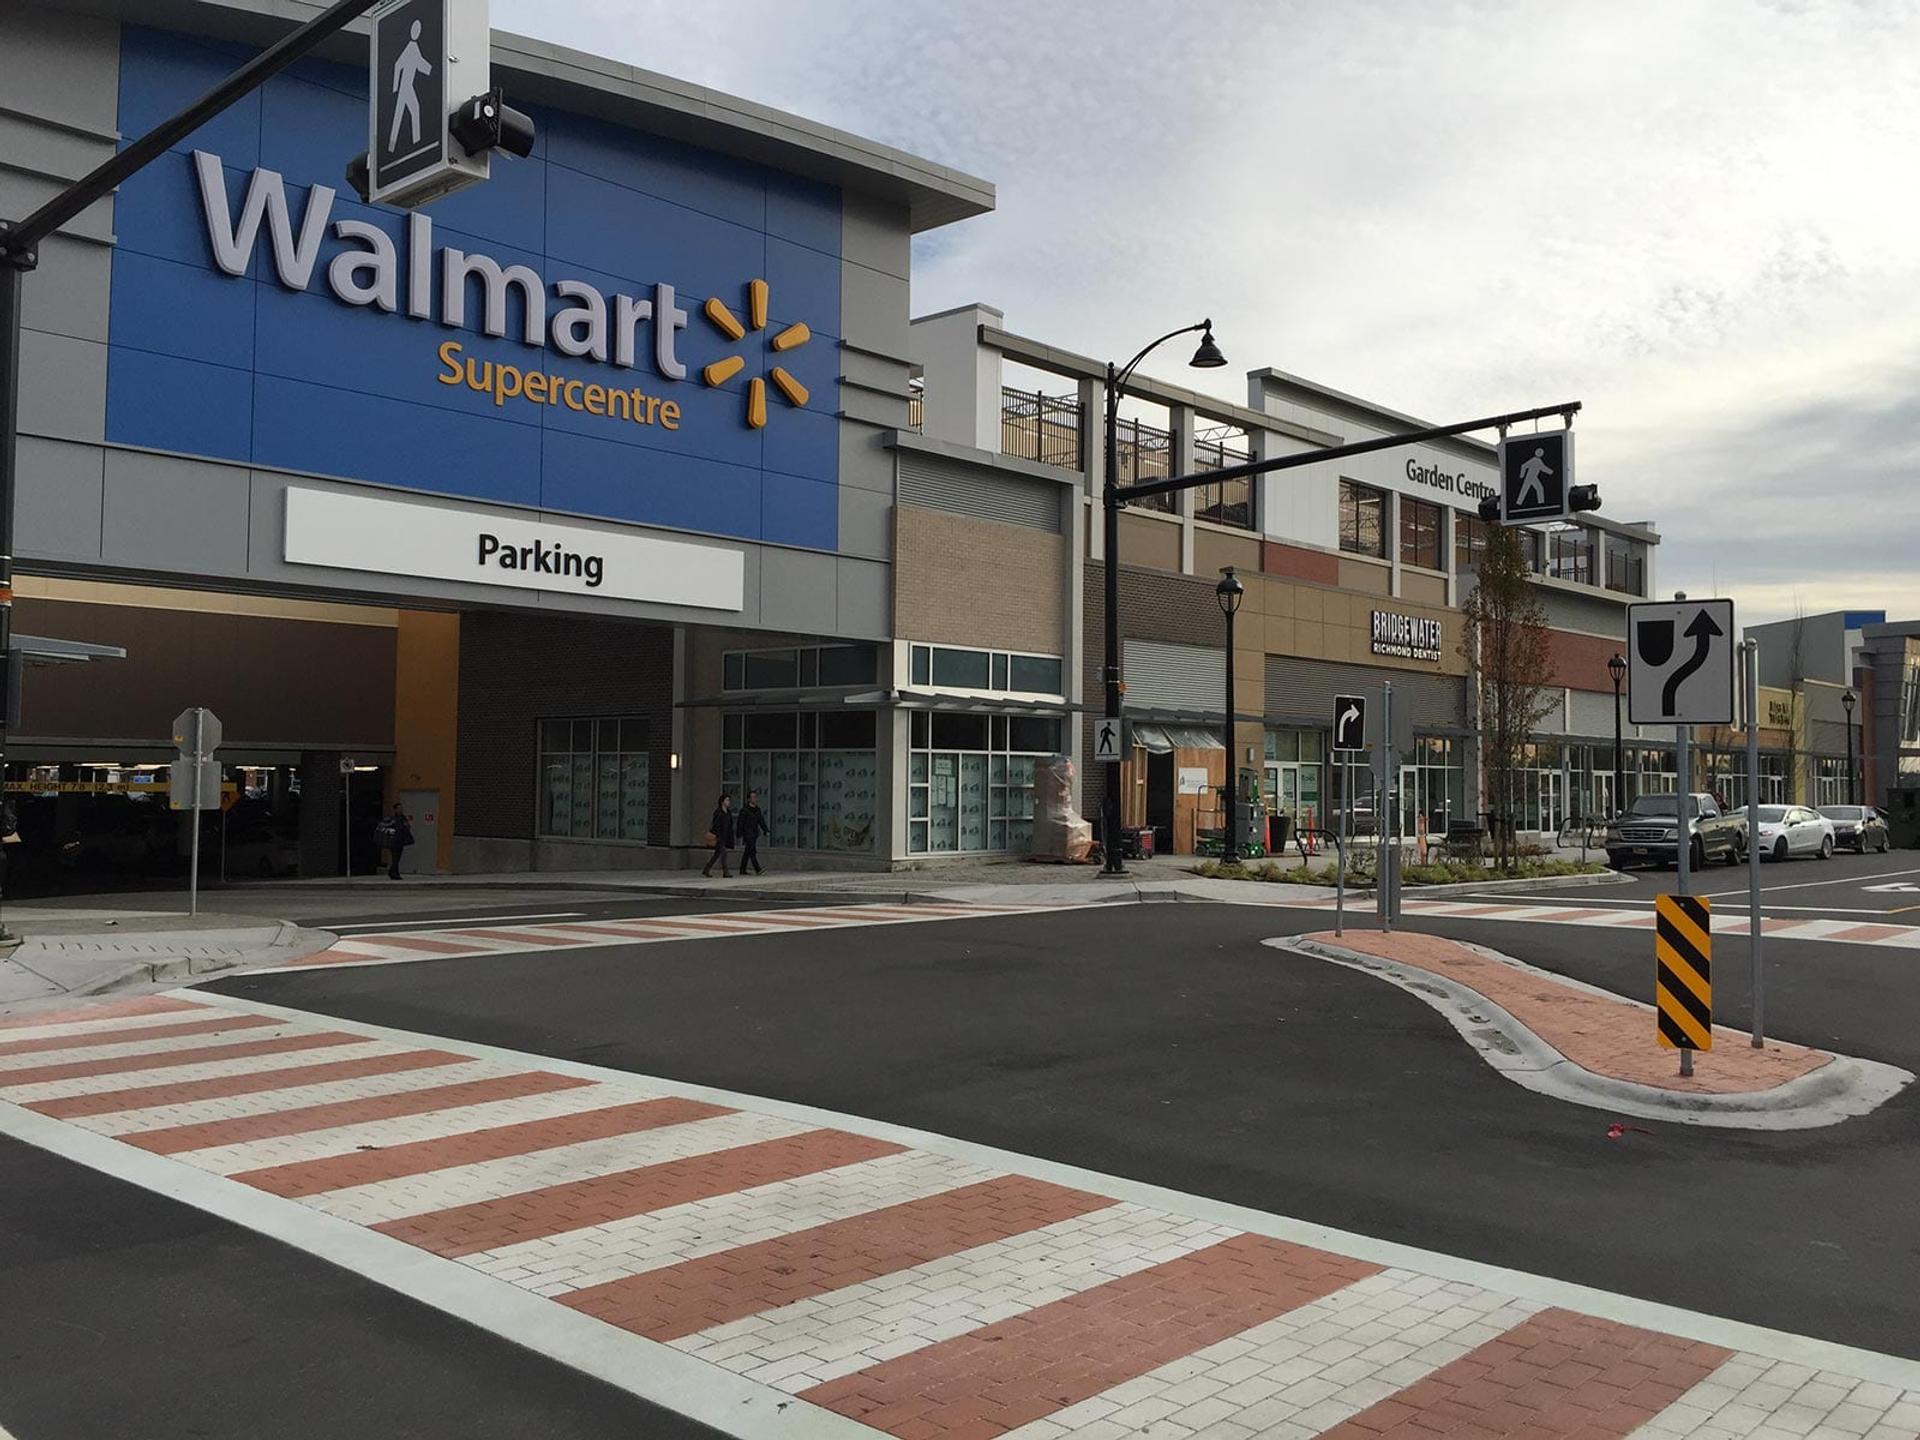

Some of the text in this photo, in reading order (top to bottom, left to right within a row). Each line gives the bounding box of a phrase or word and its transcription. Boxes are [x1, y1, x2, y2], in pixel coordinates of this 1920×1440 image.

[193, 149, 688, 379] Walmart
[438, 341, 681, 430] Supercentre
[1406, 458, 1496, 501] Garden Centre
[478, 533, 604, 587] Parking
[1373, 610, 1441, 647] BRIDGEWATER
[1373, 642, 1442, 661] RICHMOND DENTIST
[30, 782, 66, 791] HEIGHT
